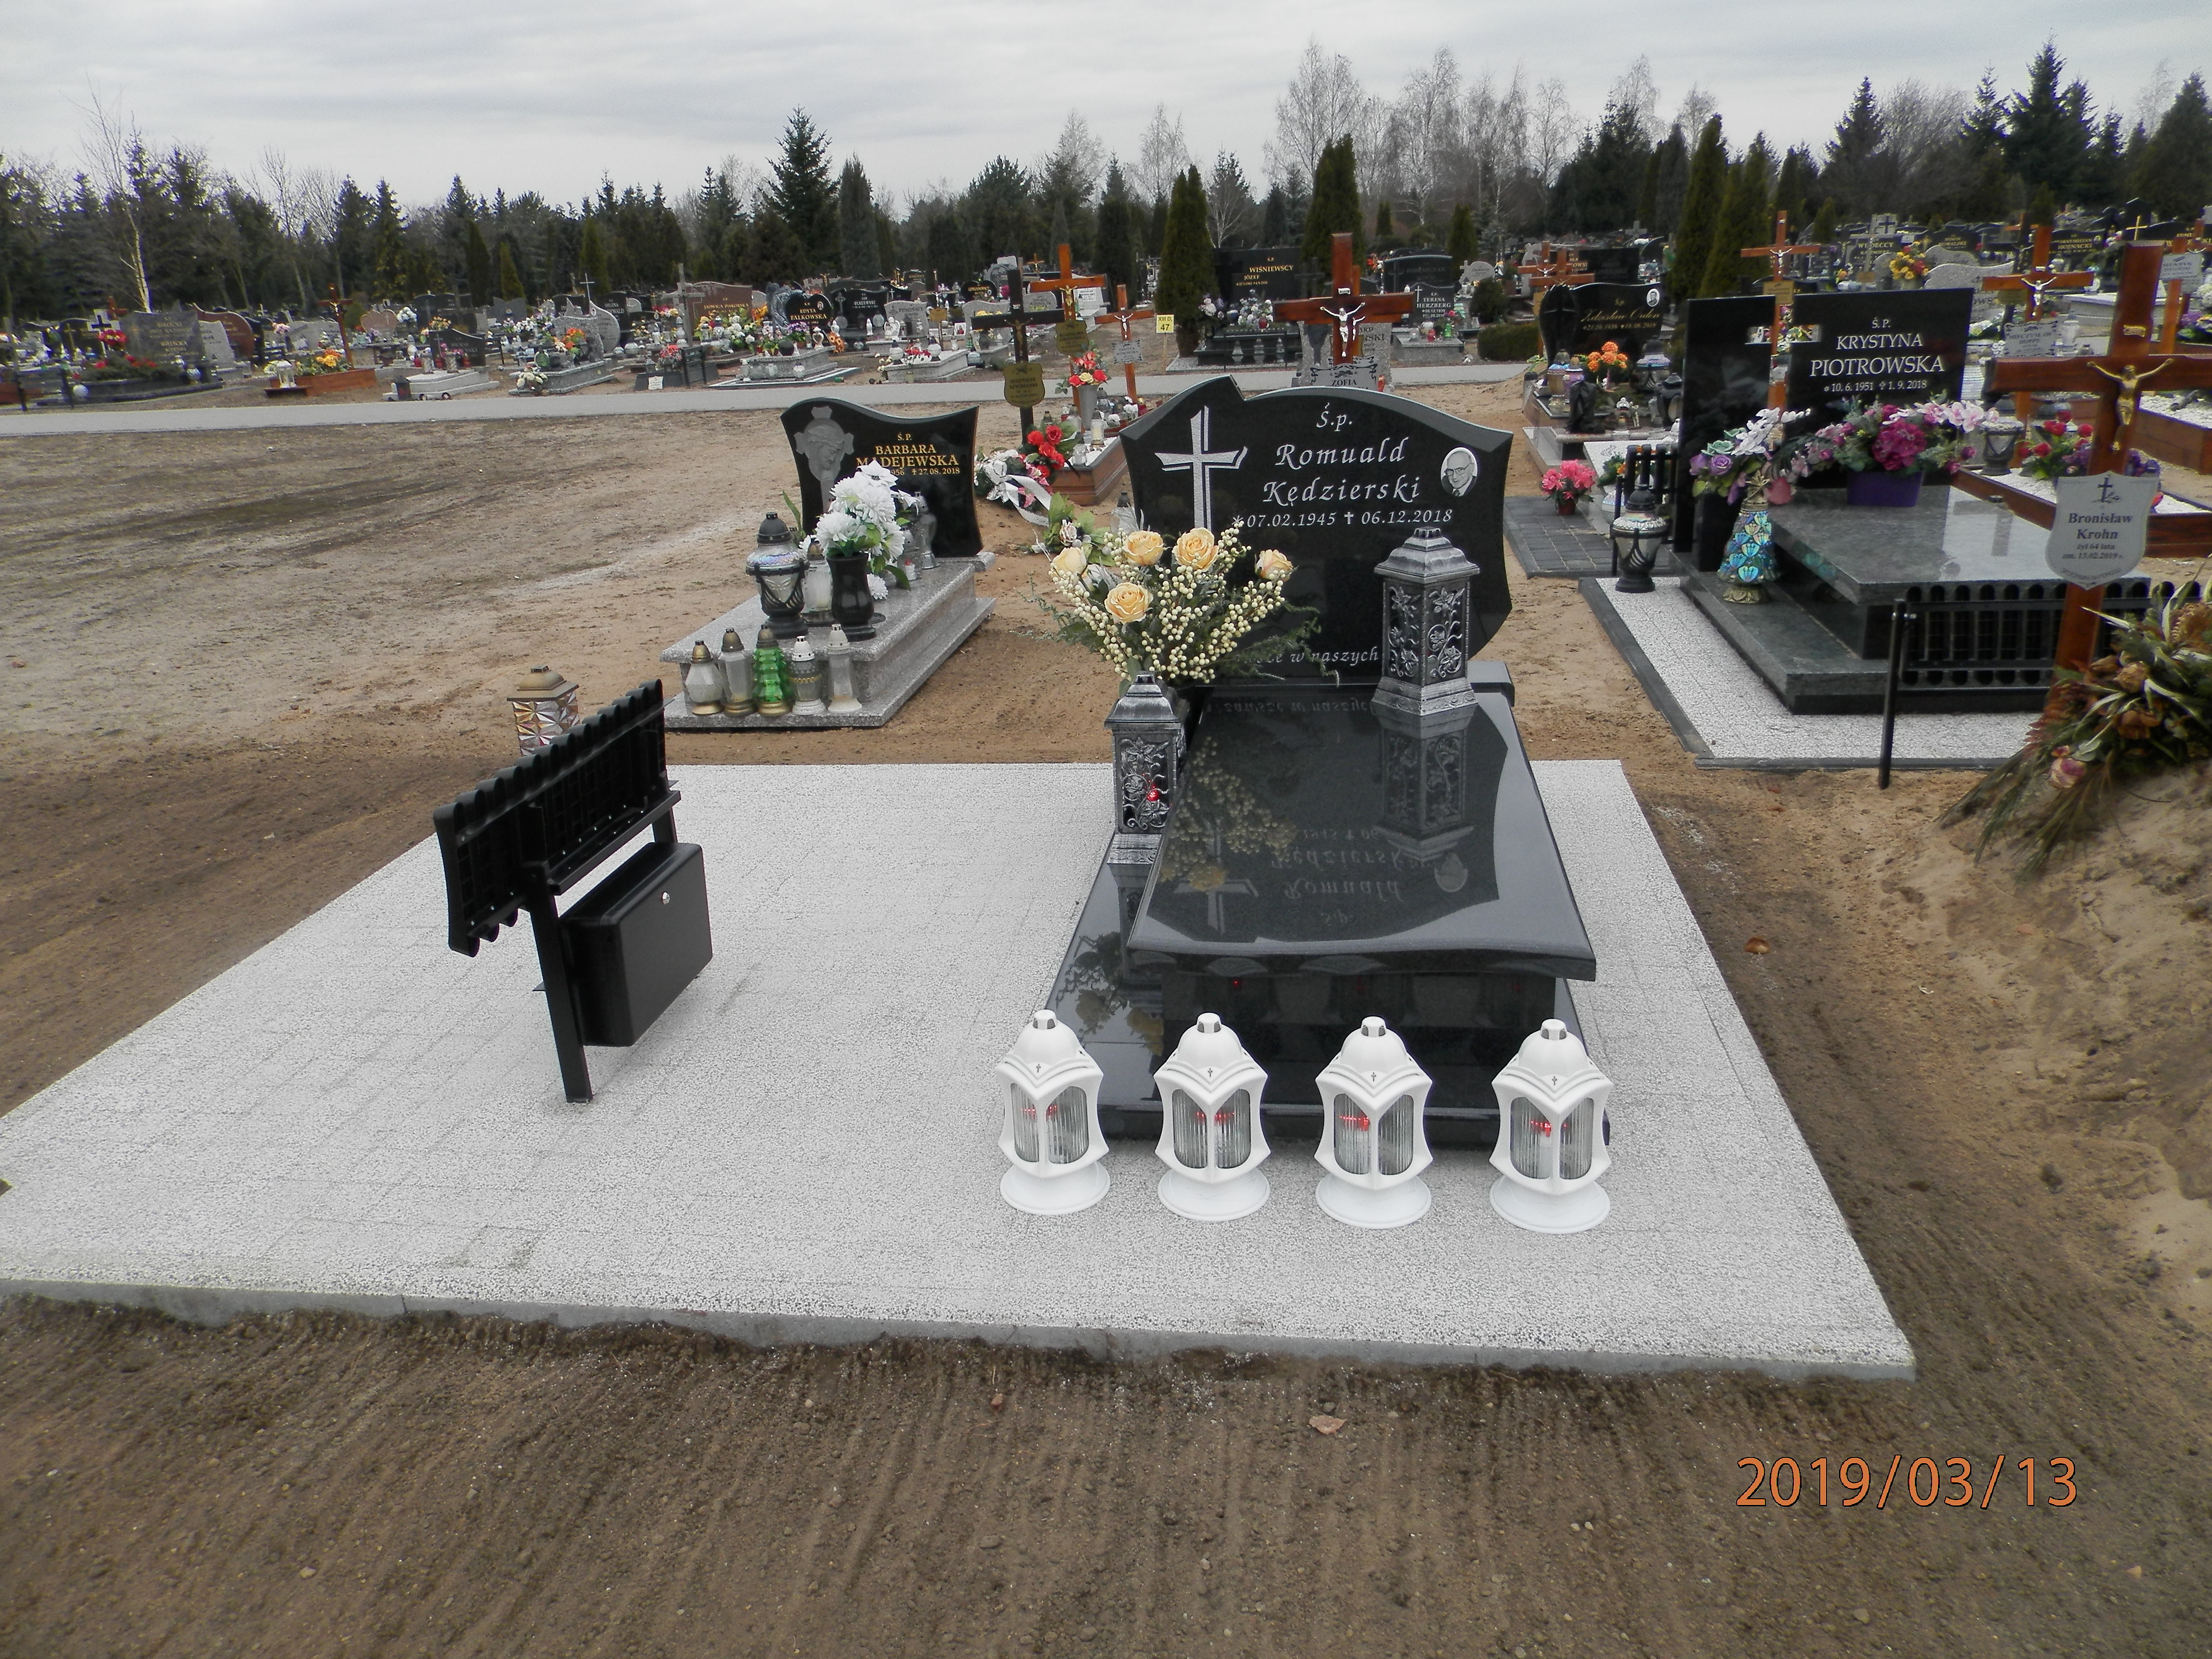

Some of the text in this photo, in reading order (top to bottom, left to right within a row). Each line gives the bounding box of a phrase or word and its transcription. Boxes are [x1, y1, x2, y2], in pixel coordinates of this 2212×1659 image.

[1836, 333, 1923, 349] KRYSTYNA
[1810, 355, 1945, 376] PIOTROWSKA
[875, 444, 937, 455] BARBARA
[1275, 436, 1409, 470] Romuald
[856, 454, 959, 469] MDEJEWSKA
[1262, 474, 1420, 506] Kędzierski
[1247, 509, 1453, 528] 07.02.1945 06.12.2018
[2068, 513, 2133, 523] Bronisław
[2077, 529, 2118, 539] Krohn
[1290, 652, 1304, 662] w
[1310, 646, 1378, 666] naszych
